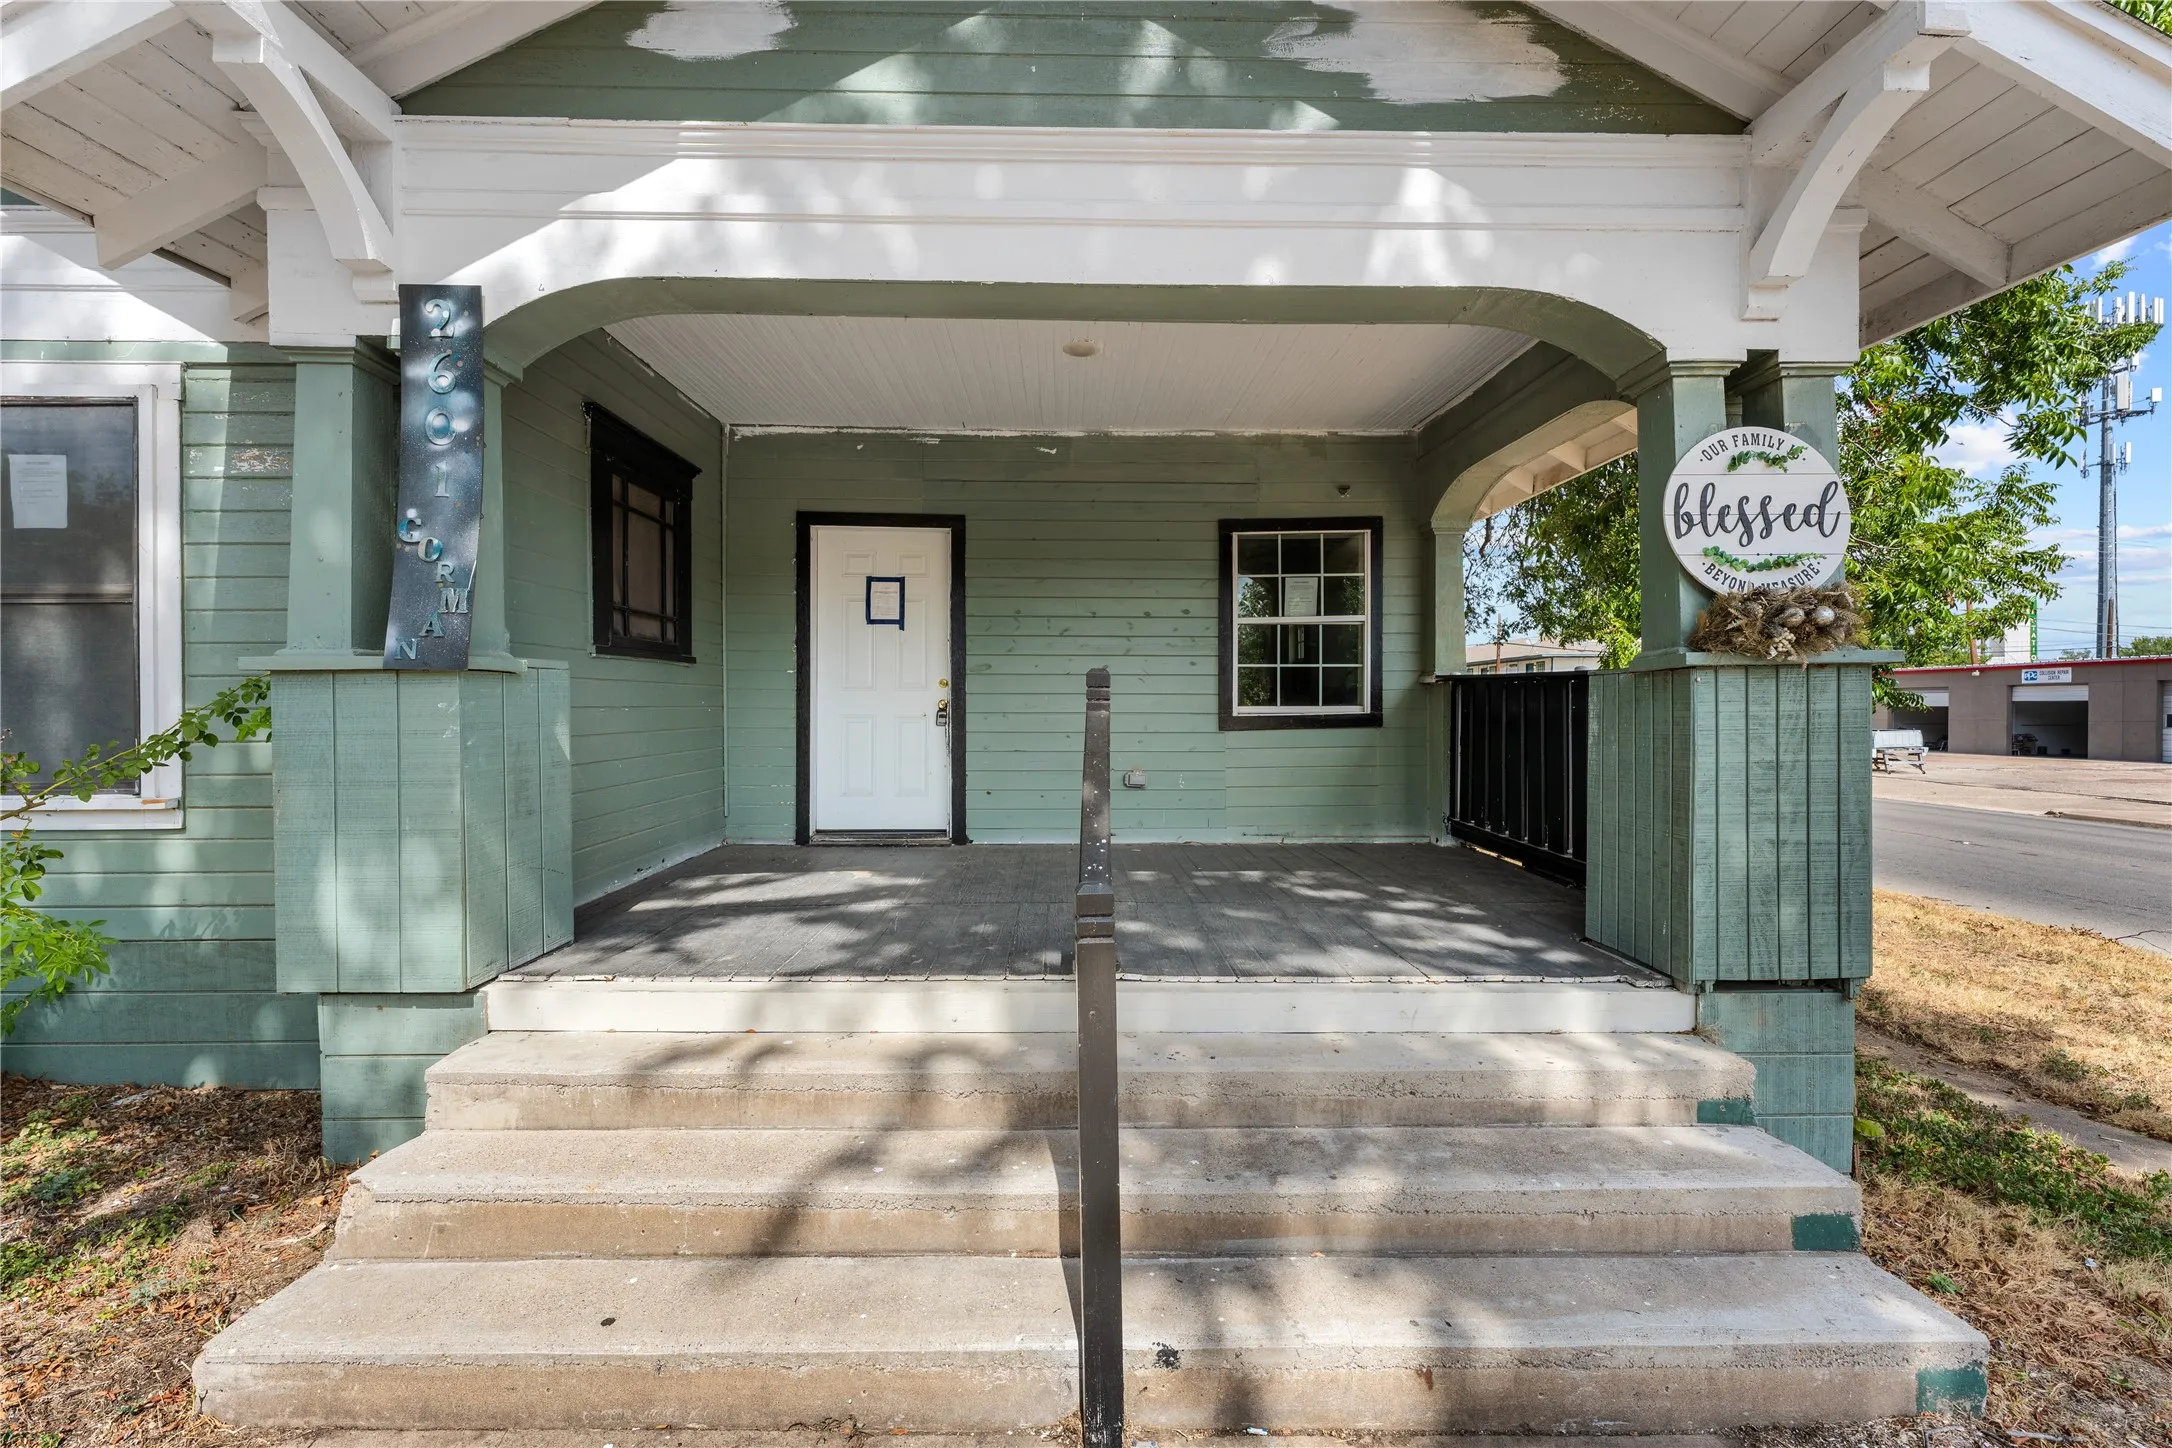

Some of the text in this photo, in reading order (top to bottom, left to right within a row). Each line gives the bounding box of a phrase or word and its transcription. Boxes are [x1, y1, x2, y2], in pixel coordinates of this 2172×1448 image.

[425, 299, 457, 498] 2601
[1701, 439, 1729, 461] OUR
[1731, 432, 1785, 451] FAMILY
[1673, 481, 1841, 547] blessed
[1704, 563, 1754, 593] BEYON
[2024, 671, 2038, 681] PPG
